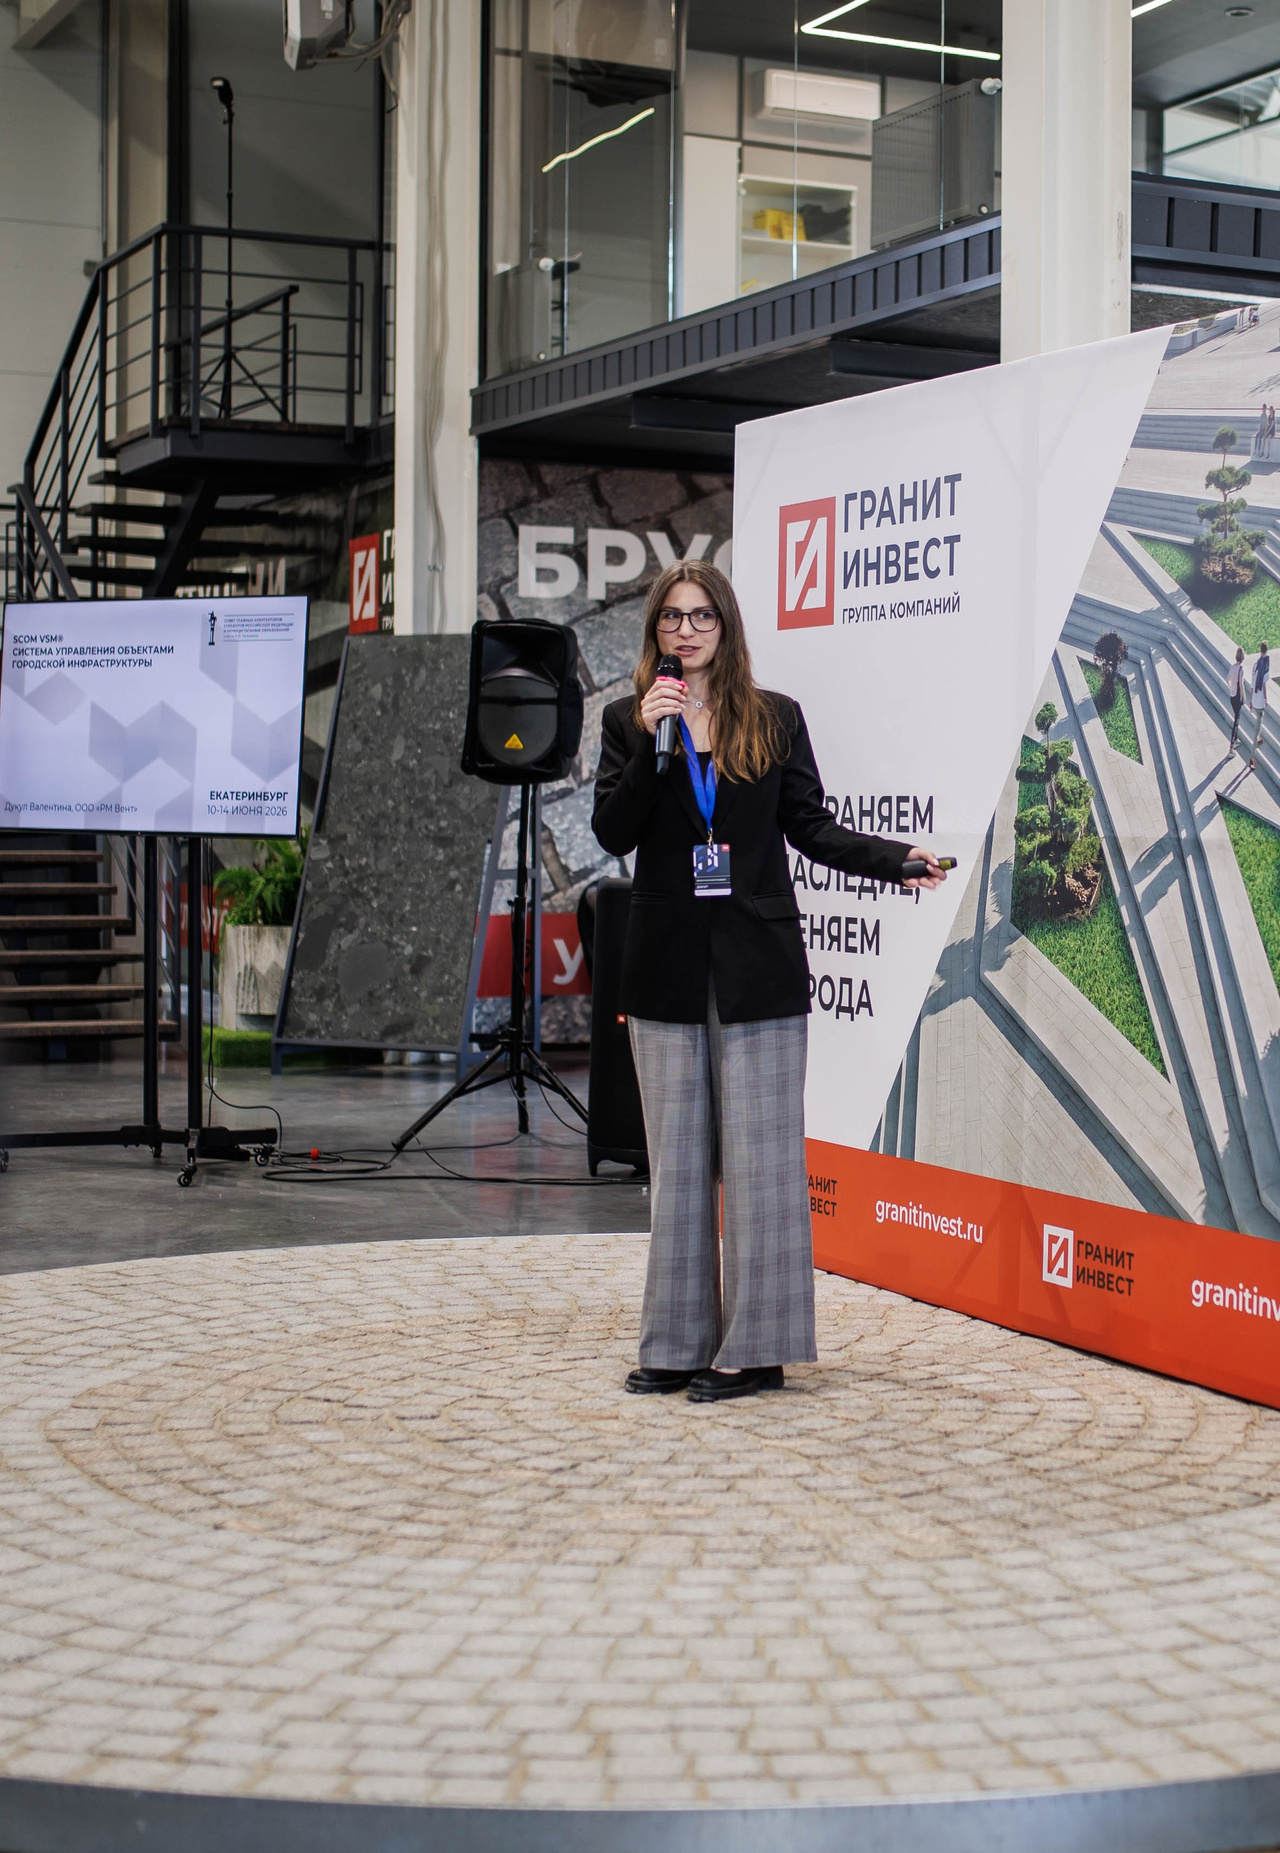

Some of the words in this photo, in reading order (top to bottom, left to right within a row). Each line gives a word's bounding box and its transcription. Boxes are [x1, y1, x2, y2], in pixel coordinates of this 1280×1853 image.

[844, 472, 962, 533] ГРАНИТ
[843, 534, 961, 590] ИНВЕСТ
[842, 603, 887, 624] ГРУППА
[889, 591, 960, 620] КОМПАНИЙ
[13, 635, 37, 644] SCOM
[12, 647, 53, 656] СИСТЕМА
[55, 646, 115, 656] УПРАВЛЕНИЯ
[117, 646, 174, 655] ОБЪЕКТАМИ
[12, 658, 65, 670] ГОРОДСКОЙ
[67, 658, 152, 668] ИНФРАСТРУКТУРЫ
[210, 791, 289, 802] ЕКАТЕРИНБУРГ
[4, 802, 28, 813] Дукул
[75, 803, 94, 813] ООО
[207, 805, 229, 816] 10-14
[231, 806, 263, 816] ИЮНЯ
[265, 806, 288, 816] 2026
[875, 1199, 983, 1244] granitinvest.ru
[1077, 1240, 1135, 1271] ГРАНИТ
[1076, 1265, 1134, 1296] ИНВЕСТ
